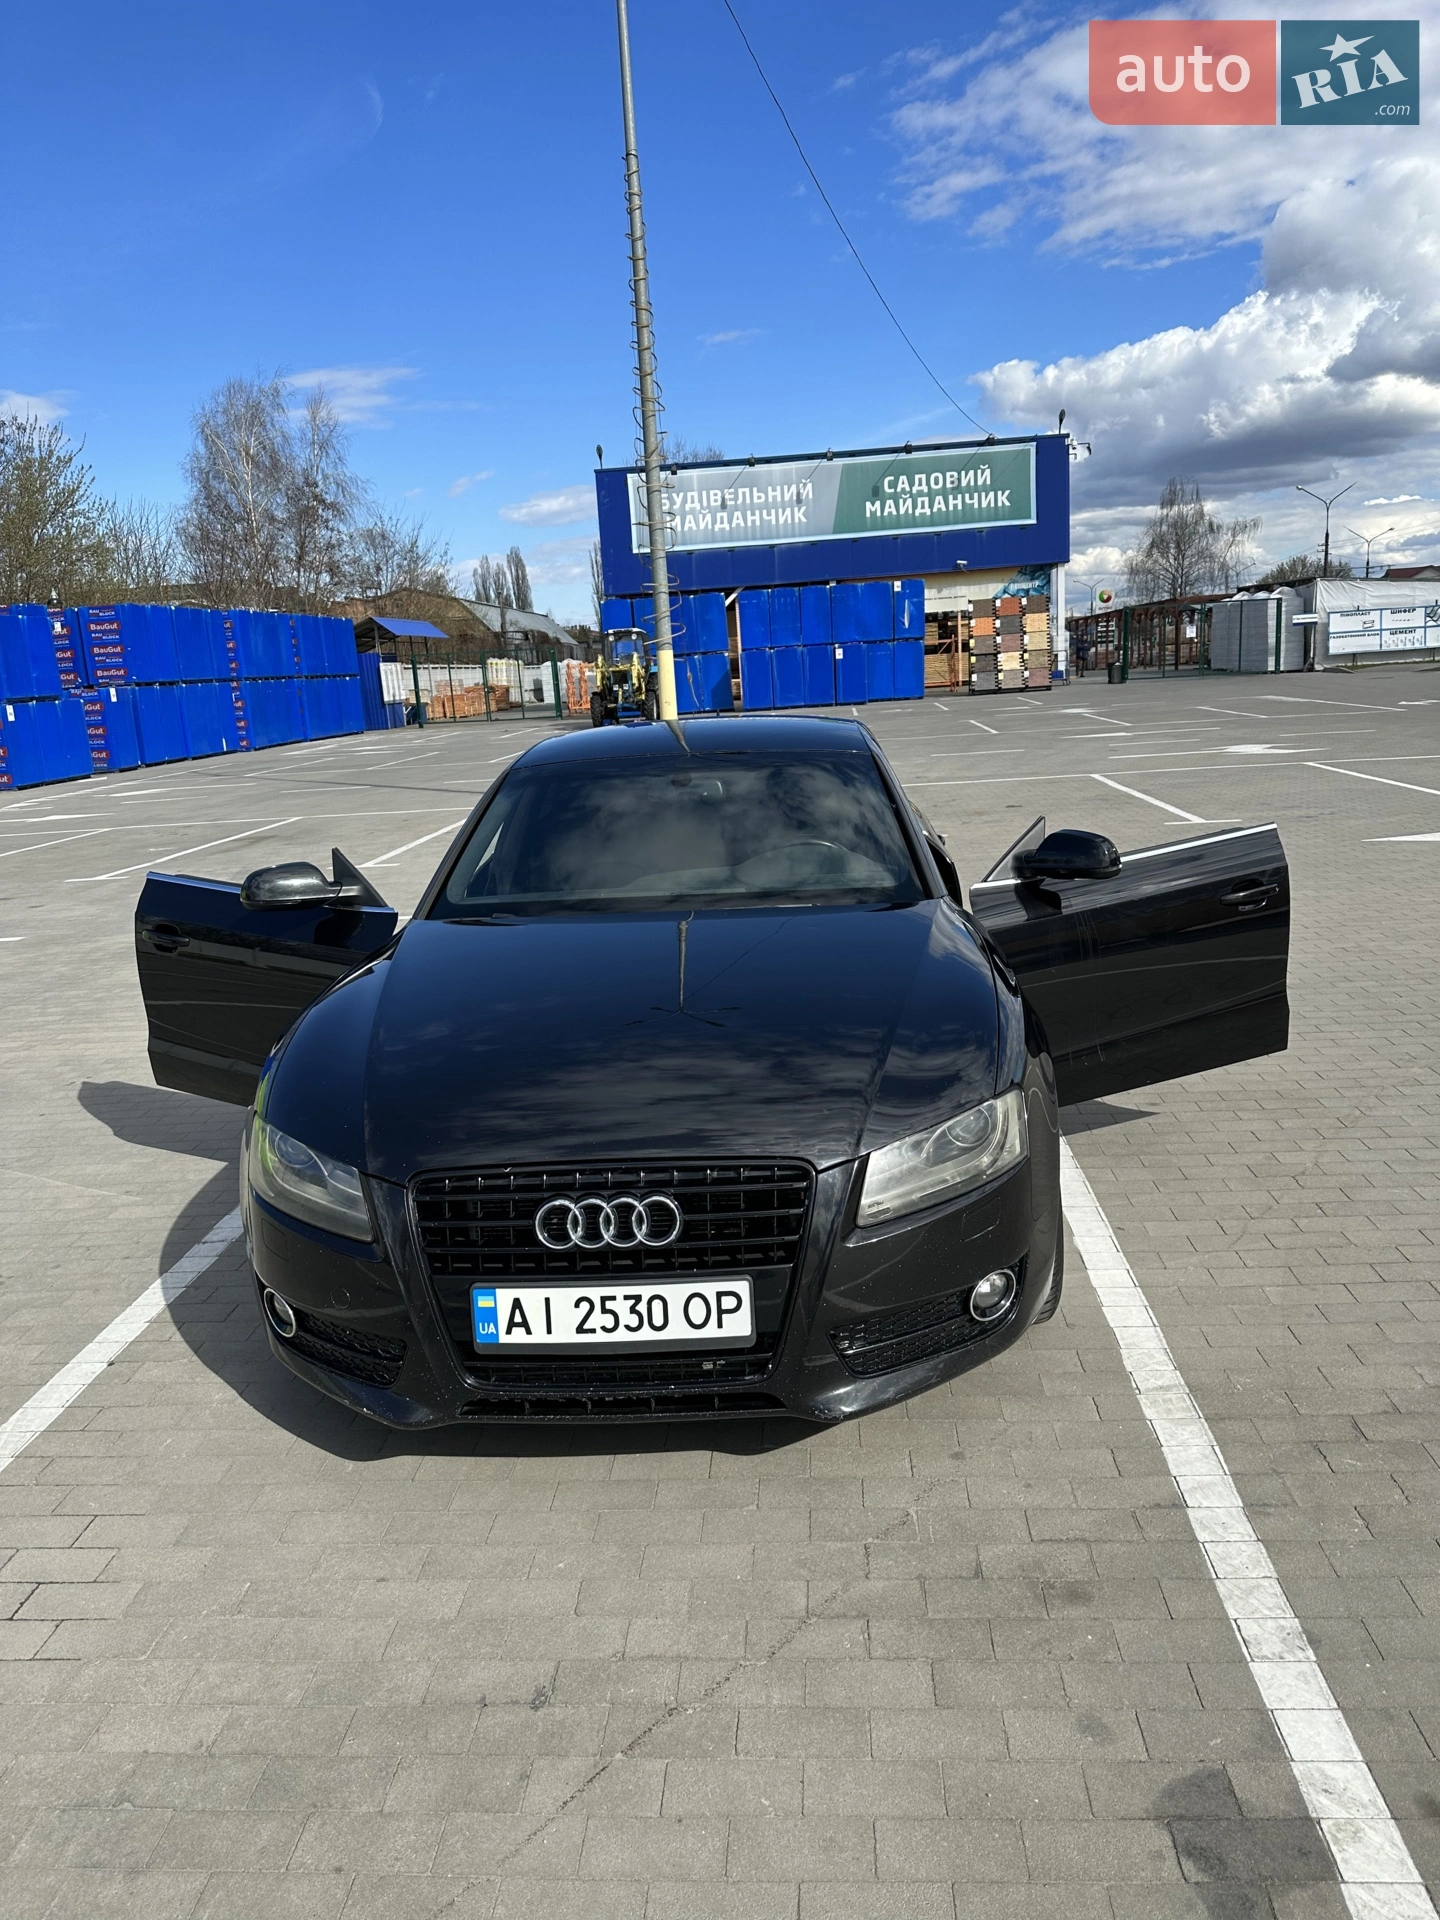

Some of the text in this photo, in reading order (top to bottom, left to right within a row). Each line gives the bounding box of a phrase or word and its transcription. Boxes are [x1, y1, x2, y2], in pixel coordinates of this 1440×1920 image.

[883, 464, 991, 494] САДОВИЙ
[866, 489, 1011, 518] МАЙДАНЧИК
[666, 506, 808, 532] МАЙДАНЧИК
[1390, 607, 1417, 615] ШИФЕР
[90, 623, 118, 631] BauGut
[93, 646, 122, 654] BauGut
[96, 669, 125, 677] BauGut
[505, 1290, 743, 1336] AI 2530 OP
[479, 1322, 496, 1335] UA
